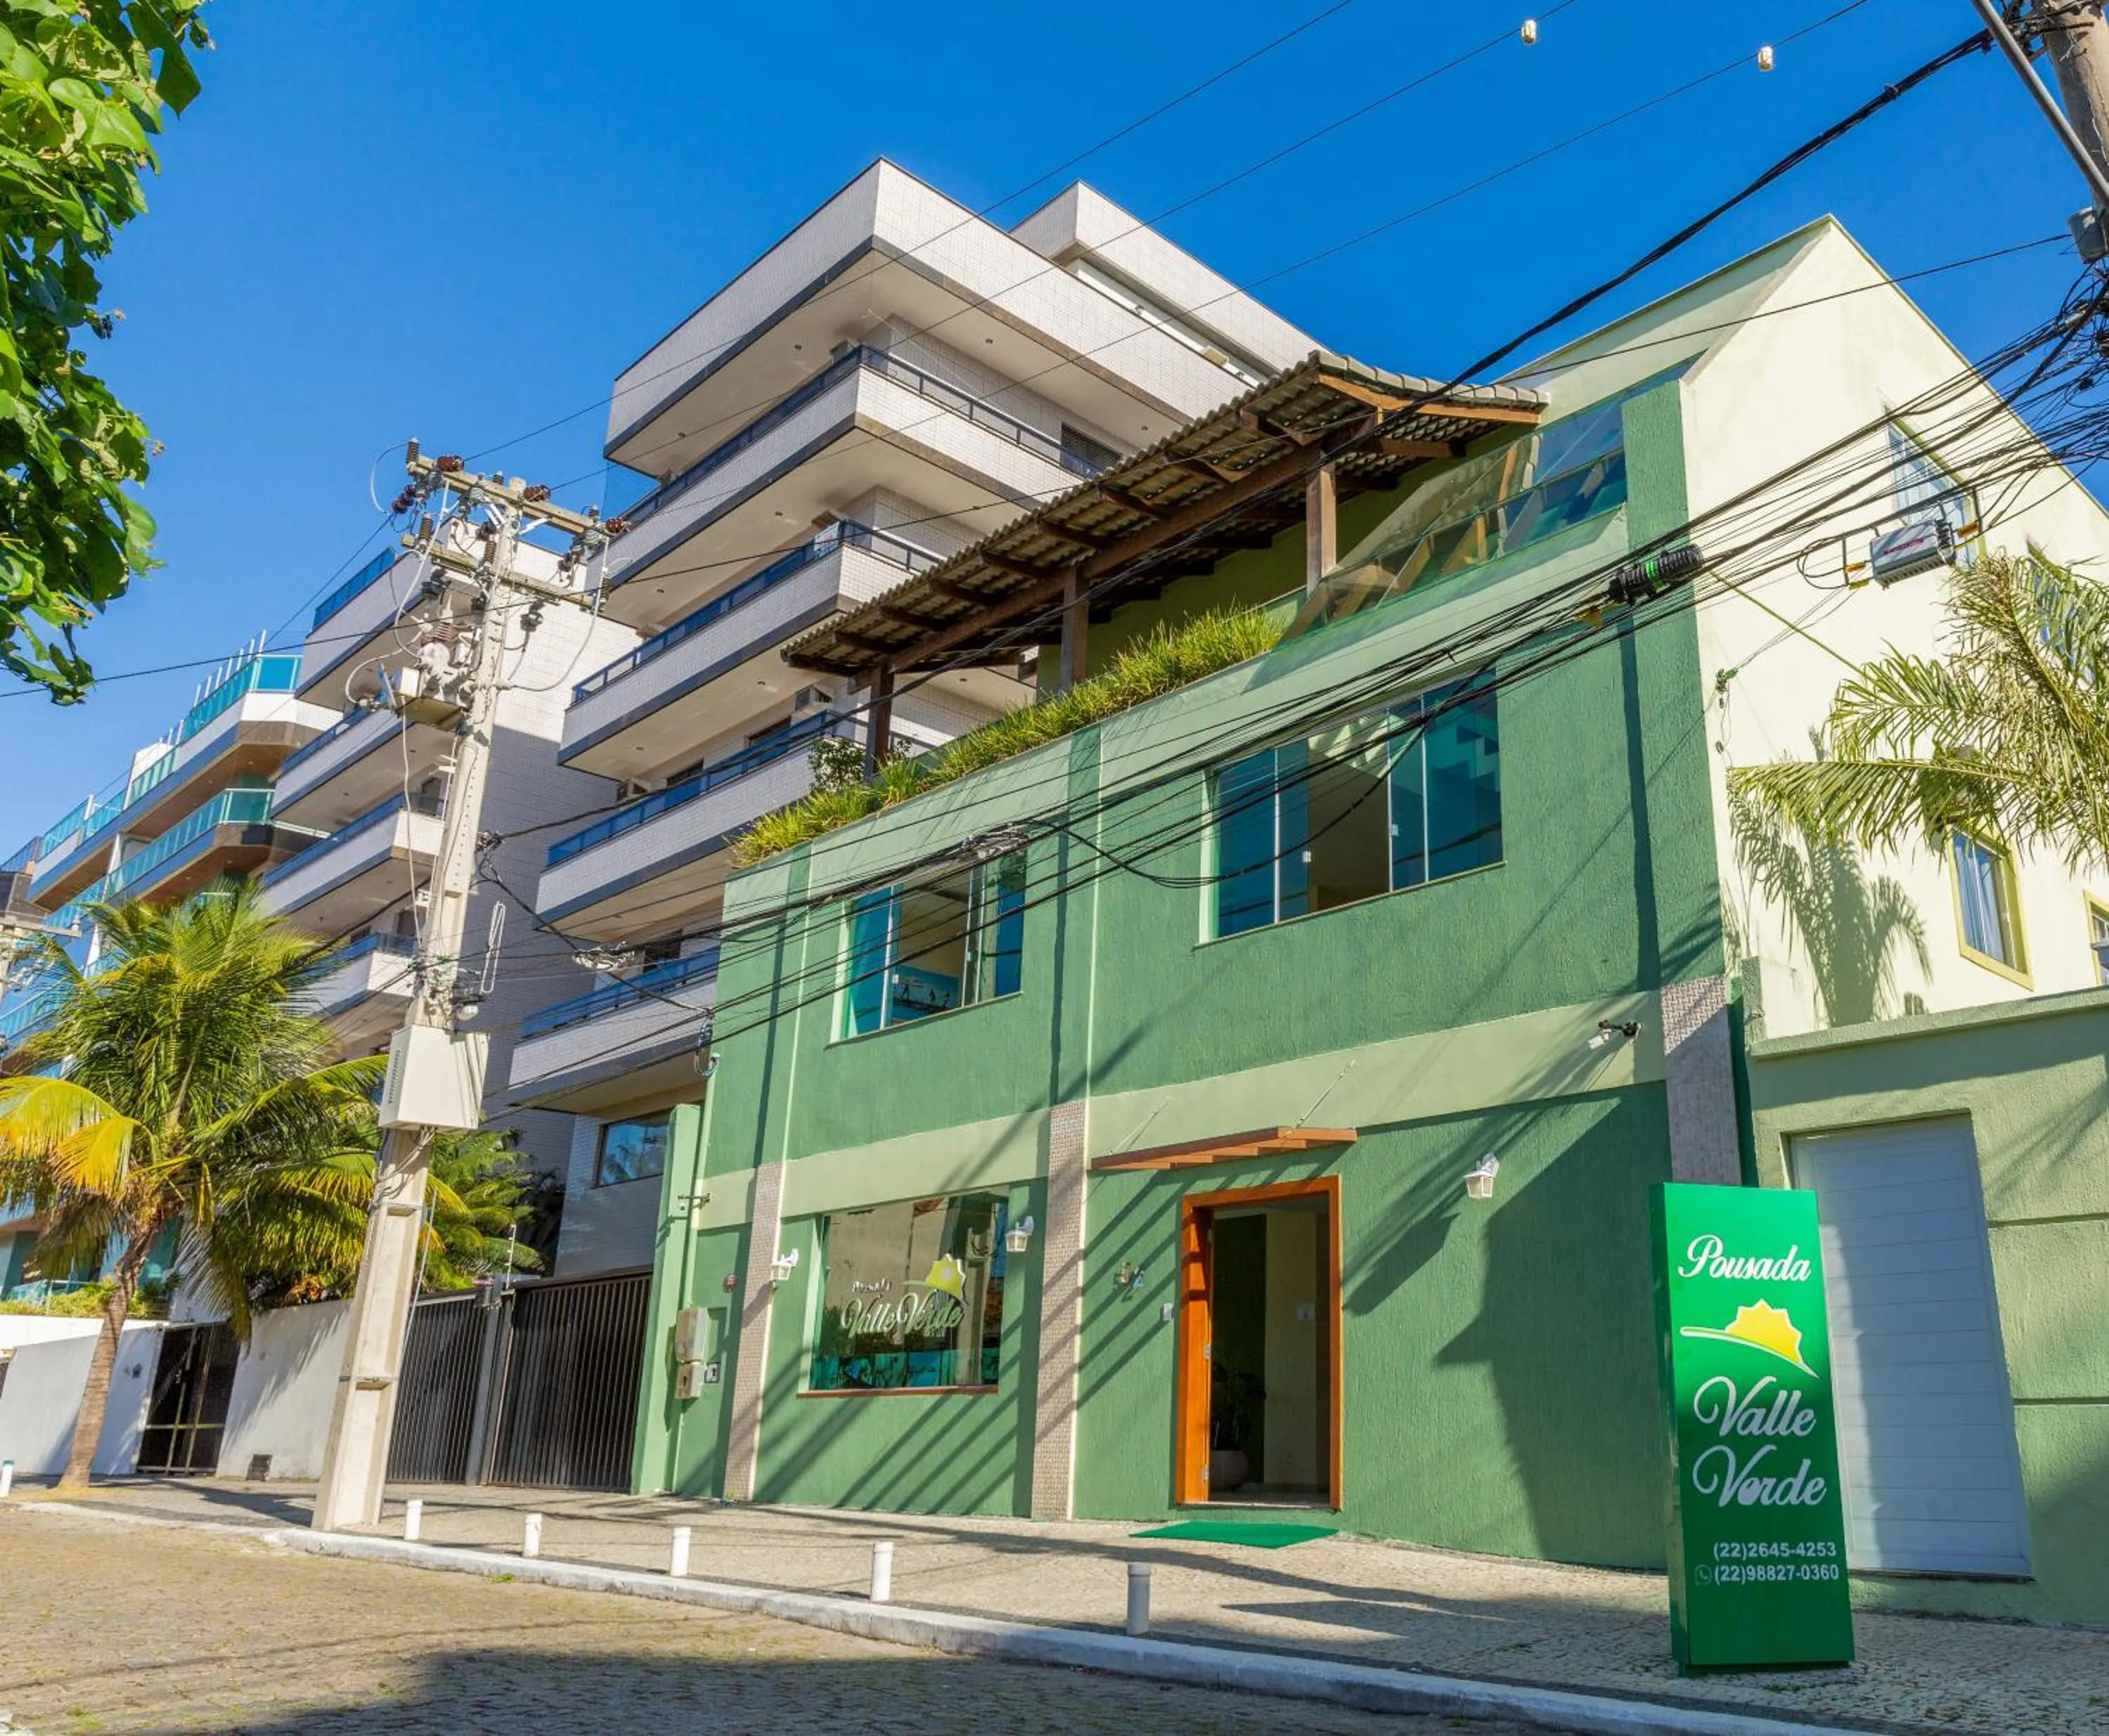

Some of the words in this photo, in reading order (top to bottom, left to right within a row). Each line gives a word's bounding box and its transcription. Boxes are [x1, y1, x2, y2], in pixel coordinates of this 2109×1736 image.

[1677, 1234, 1812, 1281] Pousada
[841, 1294, 897, 1338] Valle
[1694, 1375, 1817, 1437] Valle
[1713, 1542, 1837, 1562] (22)2645-4253
[1715, 1564, 1839, 1586] (22)98827-0360
